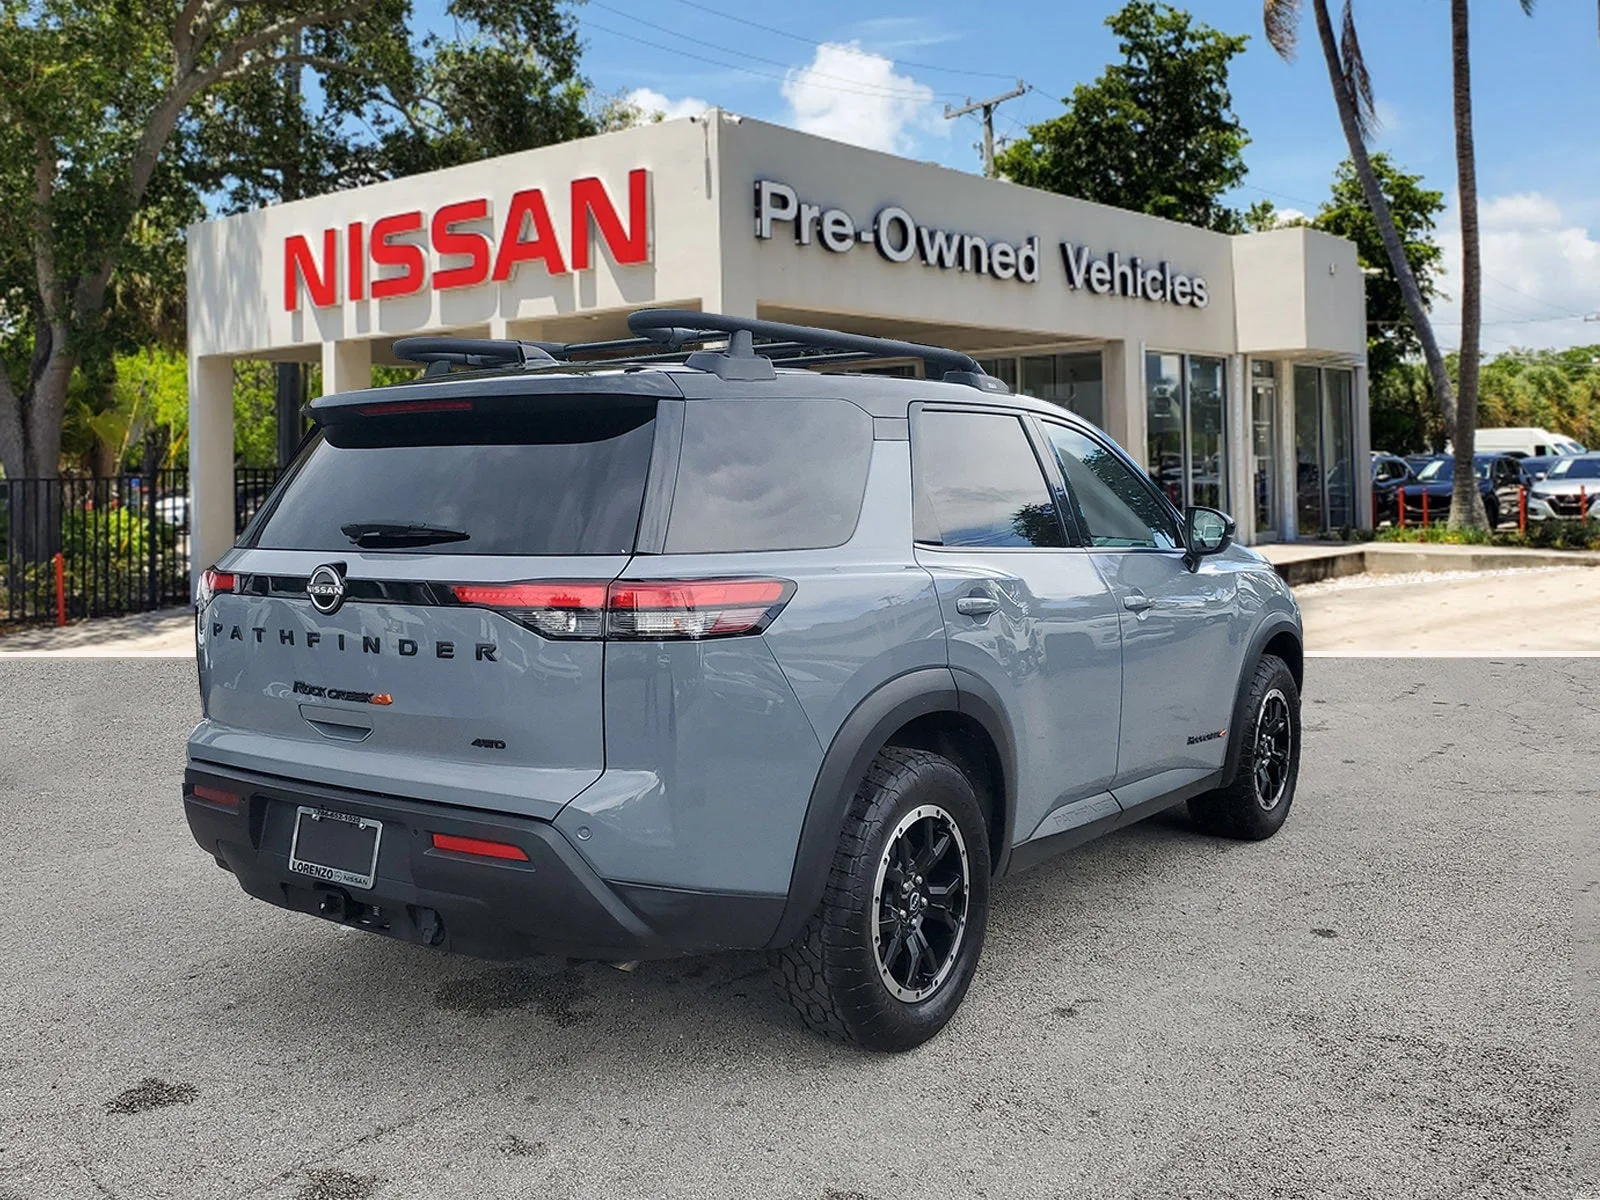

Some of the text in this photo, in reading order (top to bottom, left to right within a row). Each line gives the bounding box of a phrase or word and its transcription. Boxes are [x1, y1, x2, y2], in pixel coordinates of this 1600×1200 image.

[284, 168, 649, 312] NISSAN
[754, 179, 1208, 308] Pre-Owned Vehicles
[306, 585, 344, 595] NISSAN
[212, 622, 498, 662] PATHFINDER
[293, 680, 327, 699] ROCK
[470, 738, 507, 750] 4WD
[292, 860, 369, 886] LORENZO NISSAN
